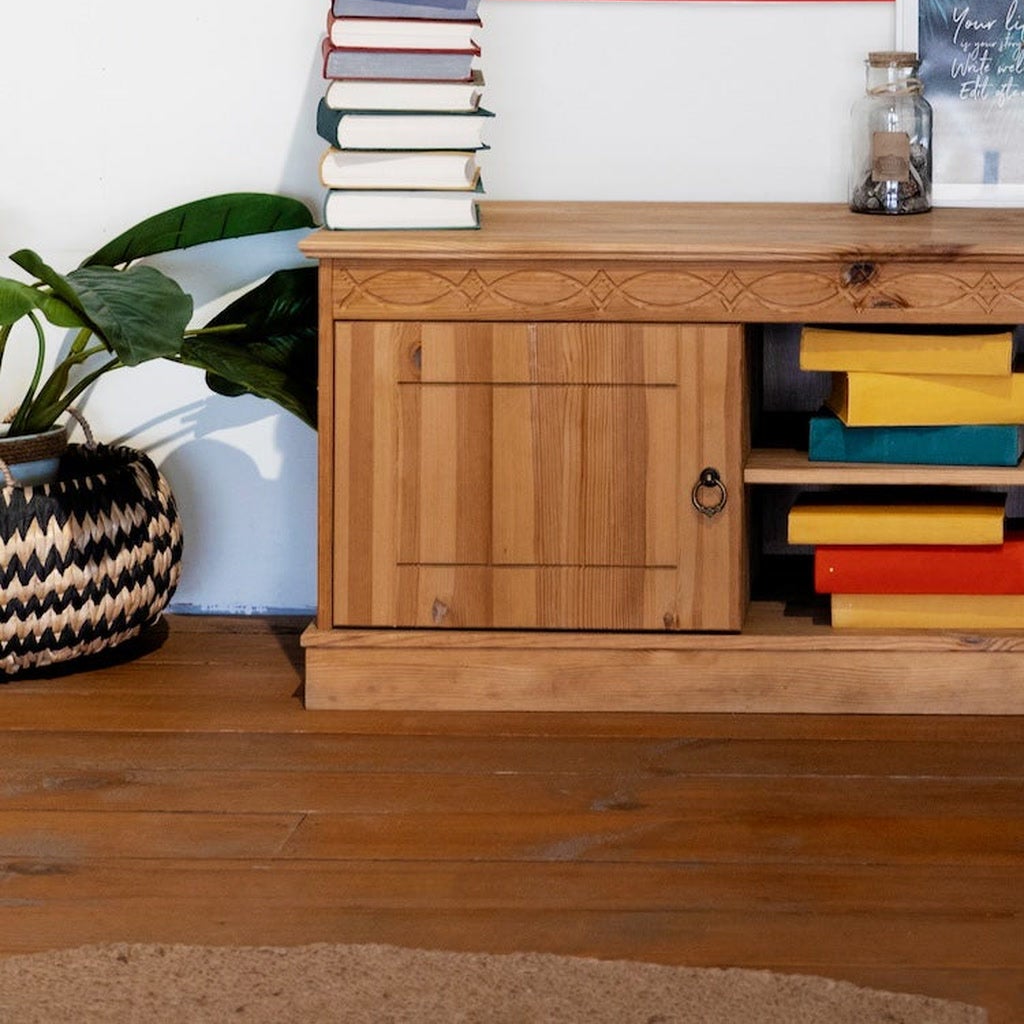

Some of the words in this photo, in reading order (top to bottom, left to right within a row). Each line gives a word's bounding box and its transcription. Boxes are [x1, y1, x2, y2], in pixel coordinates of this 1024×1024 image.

[952, 6, 997, 44] Your
[951, 49, 993, 79] Write
[974, 41, 997, 60] your
[959, 74, 994, 101] Edit
